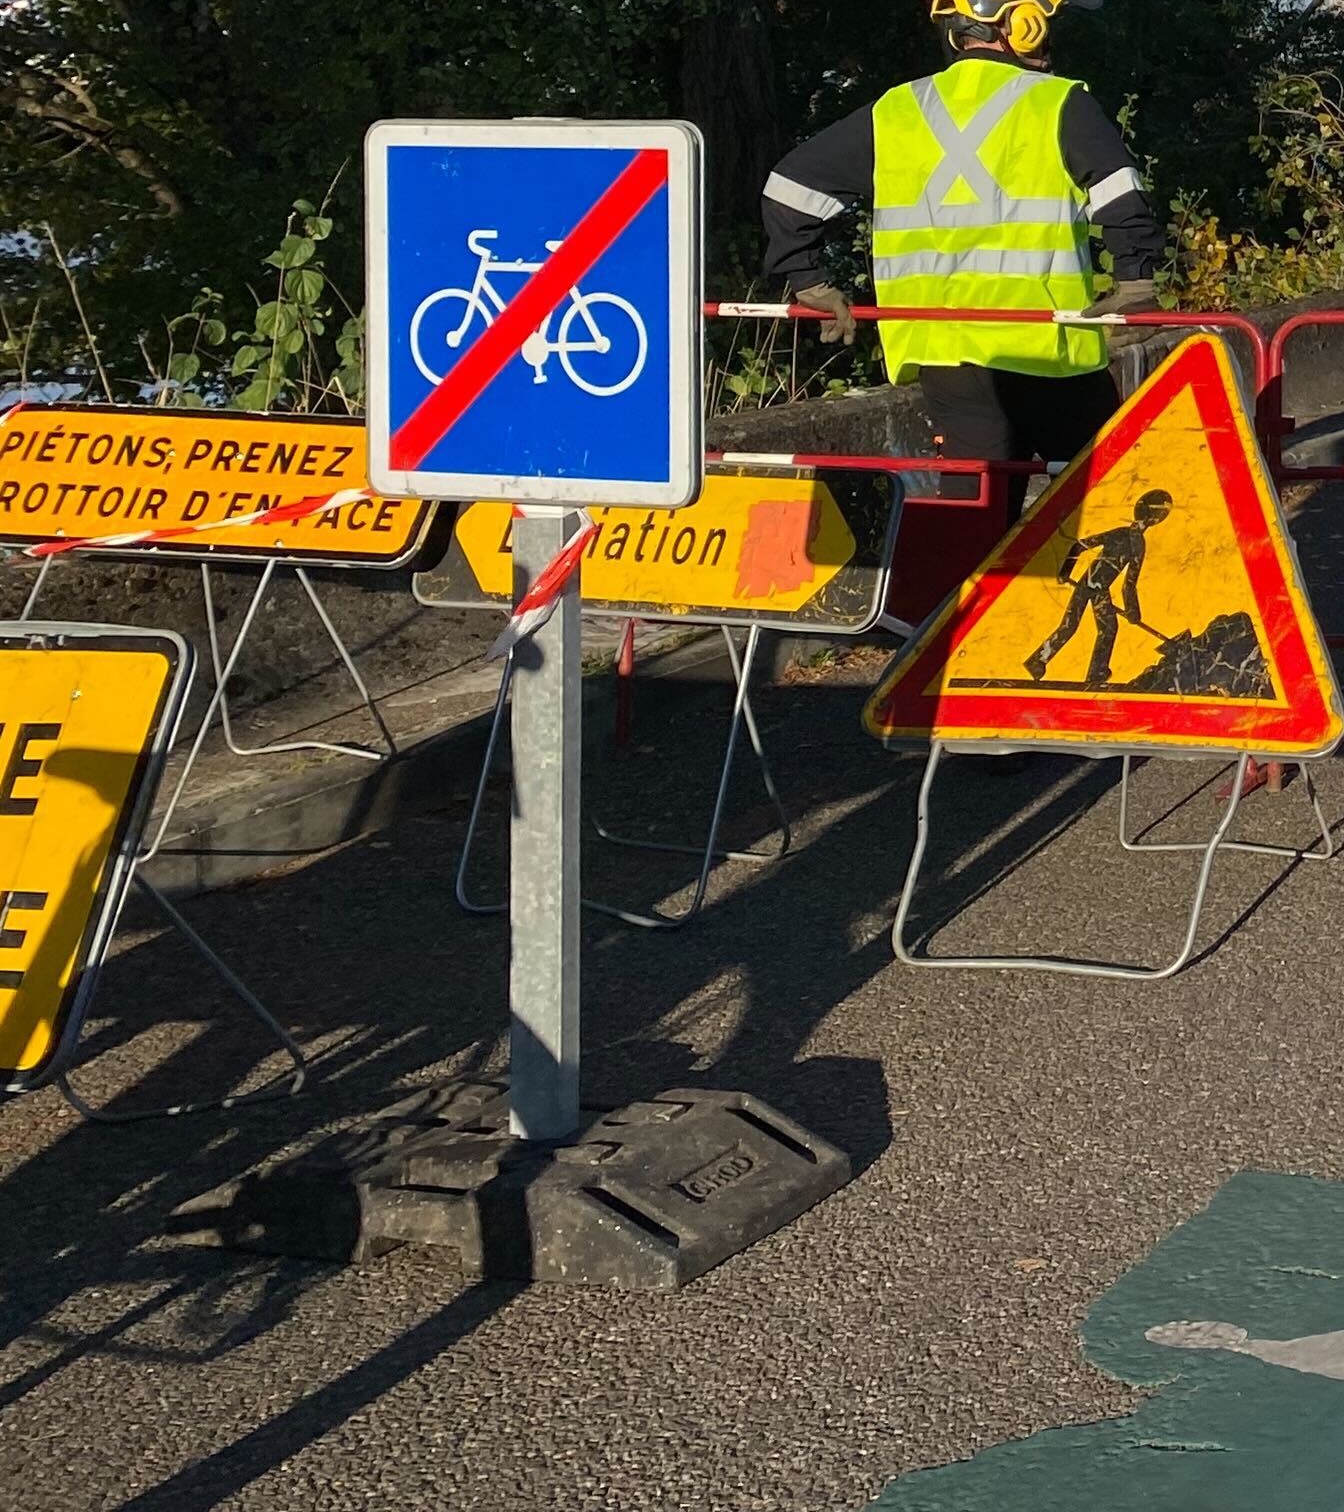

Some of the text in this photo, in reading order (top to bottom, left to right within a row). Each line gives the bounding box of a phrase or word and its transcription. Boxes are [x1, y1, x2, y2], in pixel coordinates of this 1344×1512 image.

[0, 424, 355, 478] PIÉTONS, PRENEZ
[291, 495, 403, 533] ACE
